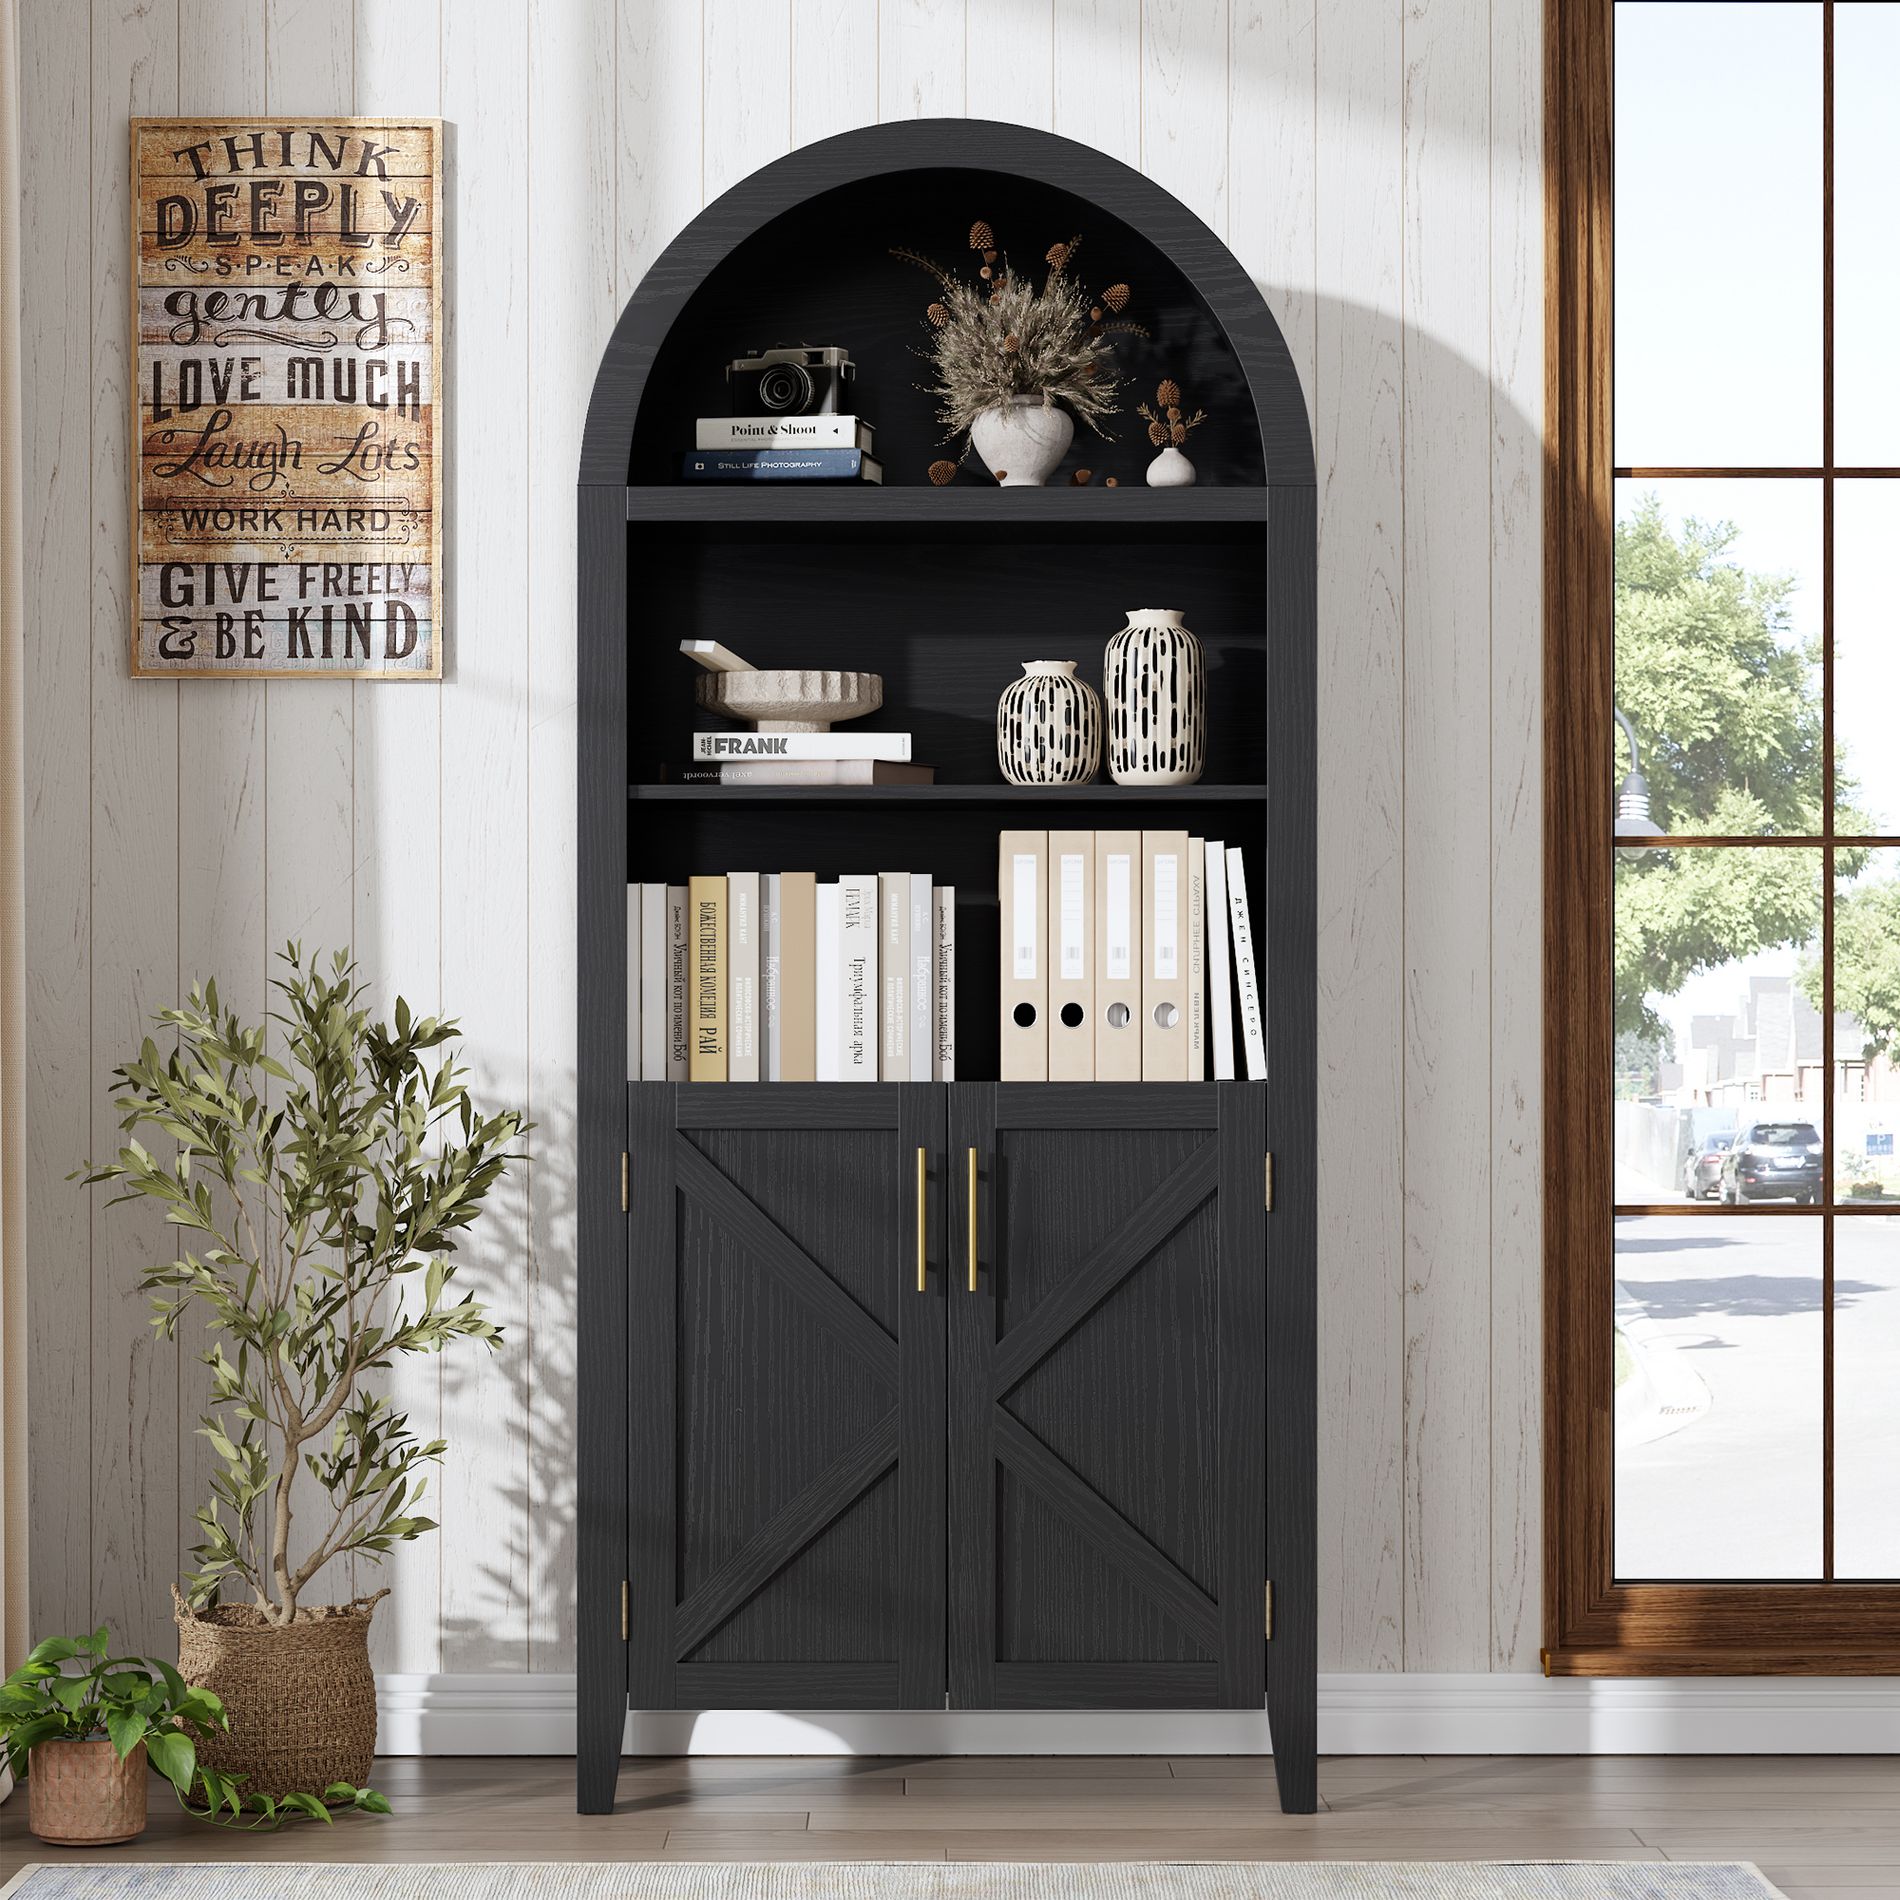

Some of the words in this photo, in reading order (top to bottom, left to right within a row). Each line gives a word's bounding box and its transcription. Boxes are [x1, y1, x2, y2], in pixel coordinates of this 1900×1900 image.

[173, 131, 400, 183] THINK
[156, 180, 422, 250] DEEPLY
[164, 281, 415, 350] gently
[152, 356, 261, 423] LOVE
[287, 356, 420, 423] MUCH
[732, 425, 764, 436] Point
[767, 425, 779, 436] &
[781, 424, 817, 435] Shoot
[147, 409, 303, 491] Laugh
[317, 421, 420, 482] Lots
[761, 461, 823, 469] PHOTOGRAPHY
[181, 509, 283, 532] WORK
[298, 509, 391, 532] HARD
[160, 562, 279, 608] GIVE
[299, 563, 418, 599] FREELY
[158, 616, 197, 659] &
[215, 609, 266, 659] BE
[287, 600, 418, 660] KIND
[715, 738, 788, 754] FRANK
[683, 771, 730, 780] vervoordt
[732, 772, 752, 780] axel
[700, 902, 716, 973] БОЖЕСТВЕННАЯ
[673, 943, 687, 983] Уличный
[939, 943, 953, 982] Уличный
[1234, 897, 1247, 943] ДЖЕН
[1242, 957, 1257, 1036] СИНСЕРО
[673, 985, 683, 999] кот
[700, 976, 716, 1019] КОМЕДИЯ
[849, 957, 867, 1036] Триумфальная
[939, 985, 949, 999] кот
[673, 1002, 683, 1013] по
[939, 1002, 949, 1013] по
[673, 1014, 683, 1042] имени
[699, 1027, 722, 1054] РАЙ
[939, 1014, 949, 1042] имени
[673, 1044, 687, 1061] Боб
[849, 1040, 863, 1065] арка
[939, 1044, 953, 1061] Боб
